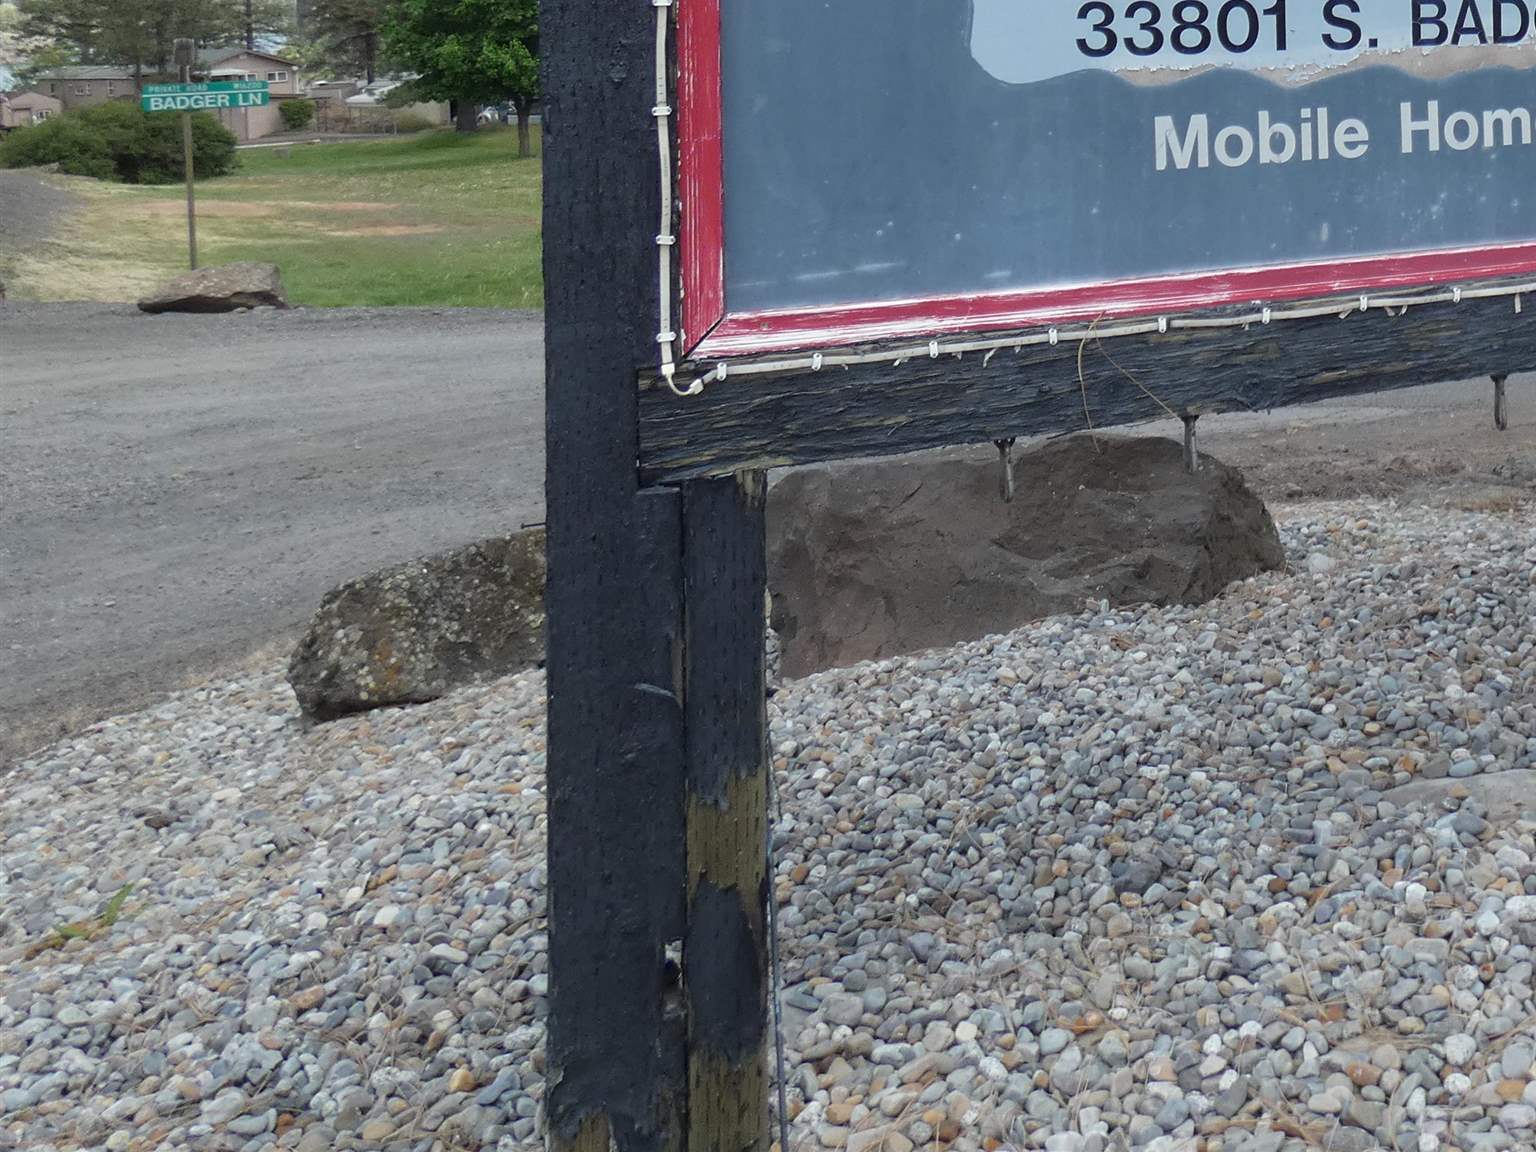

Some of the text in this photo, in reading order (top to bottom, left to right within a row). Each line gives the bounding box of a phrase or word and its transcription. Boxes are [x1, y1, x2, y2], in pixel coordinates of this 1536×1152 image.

[150, 92, 262, 111] BADGER LN
[1153, 106, 1370, 171] Mobile
